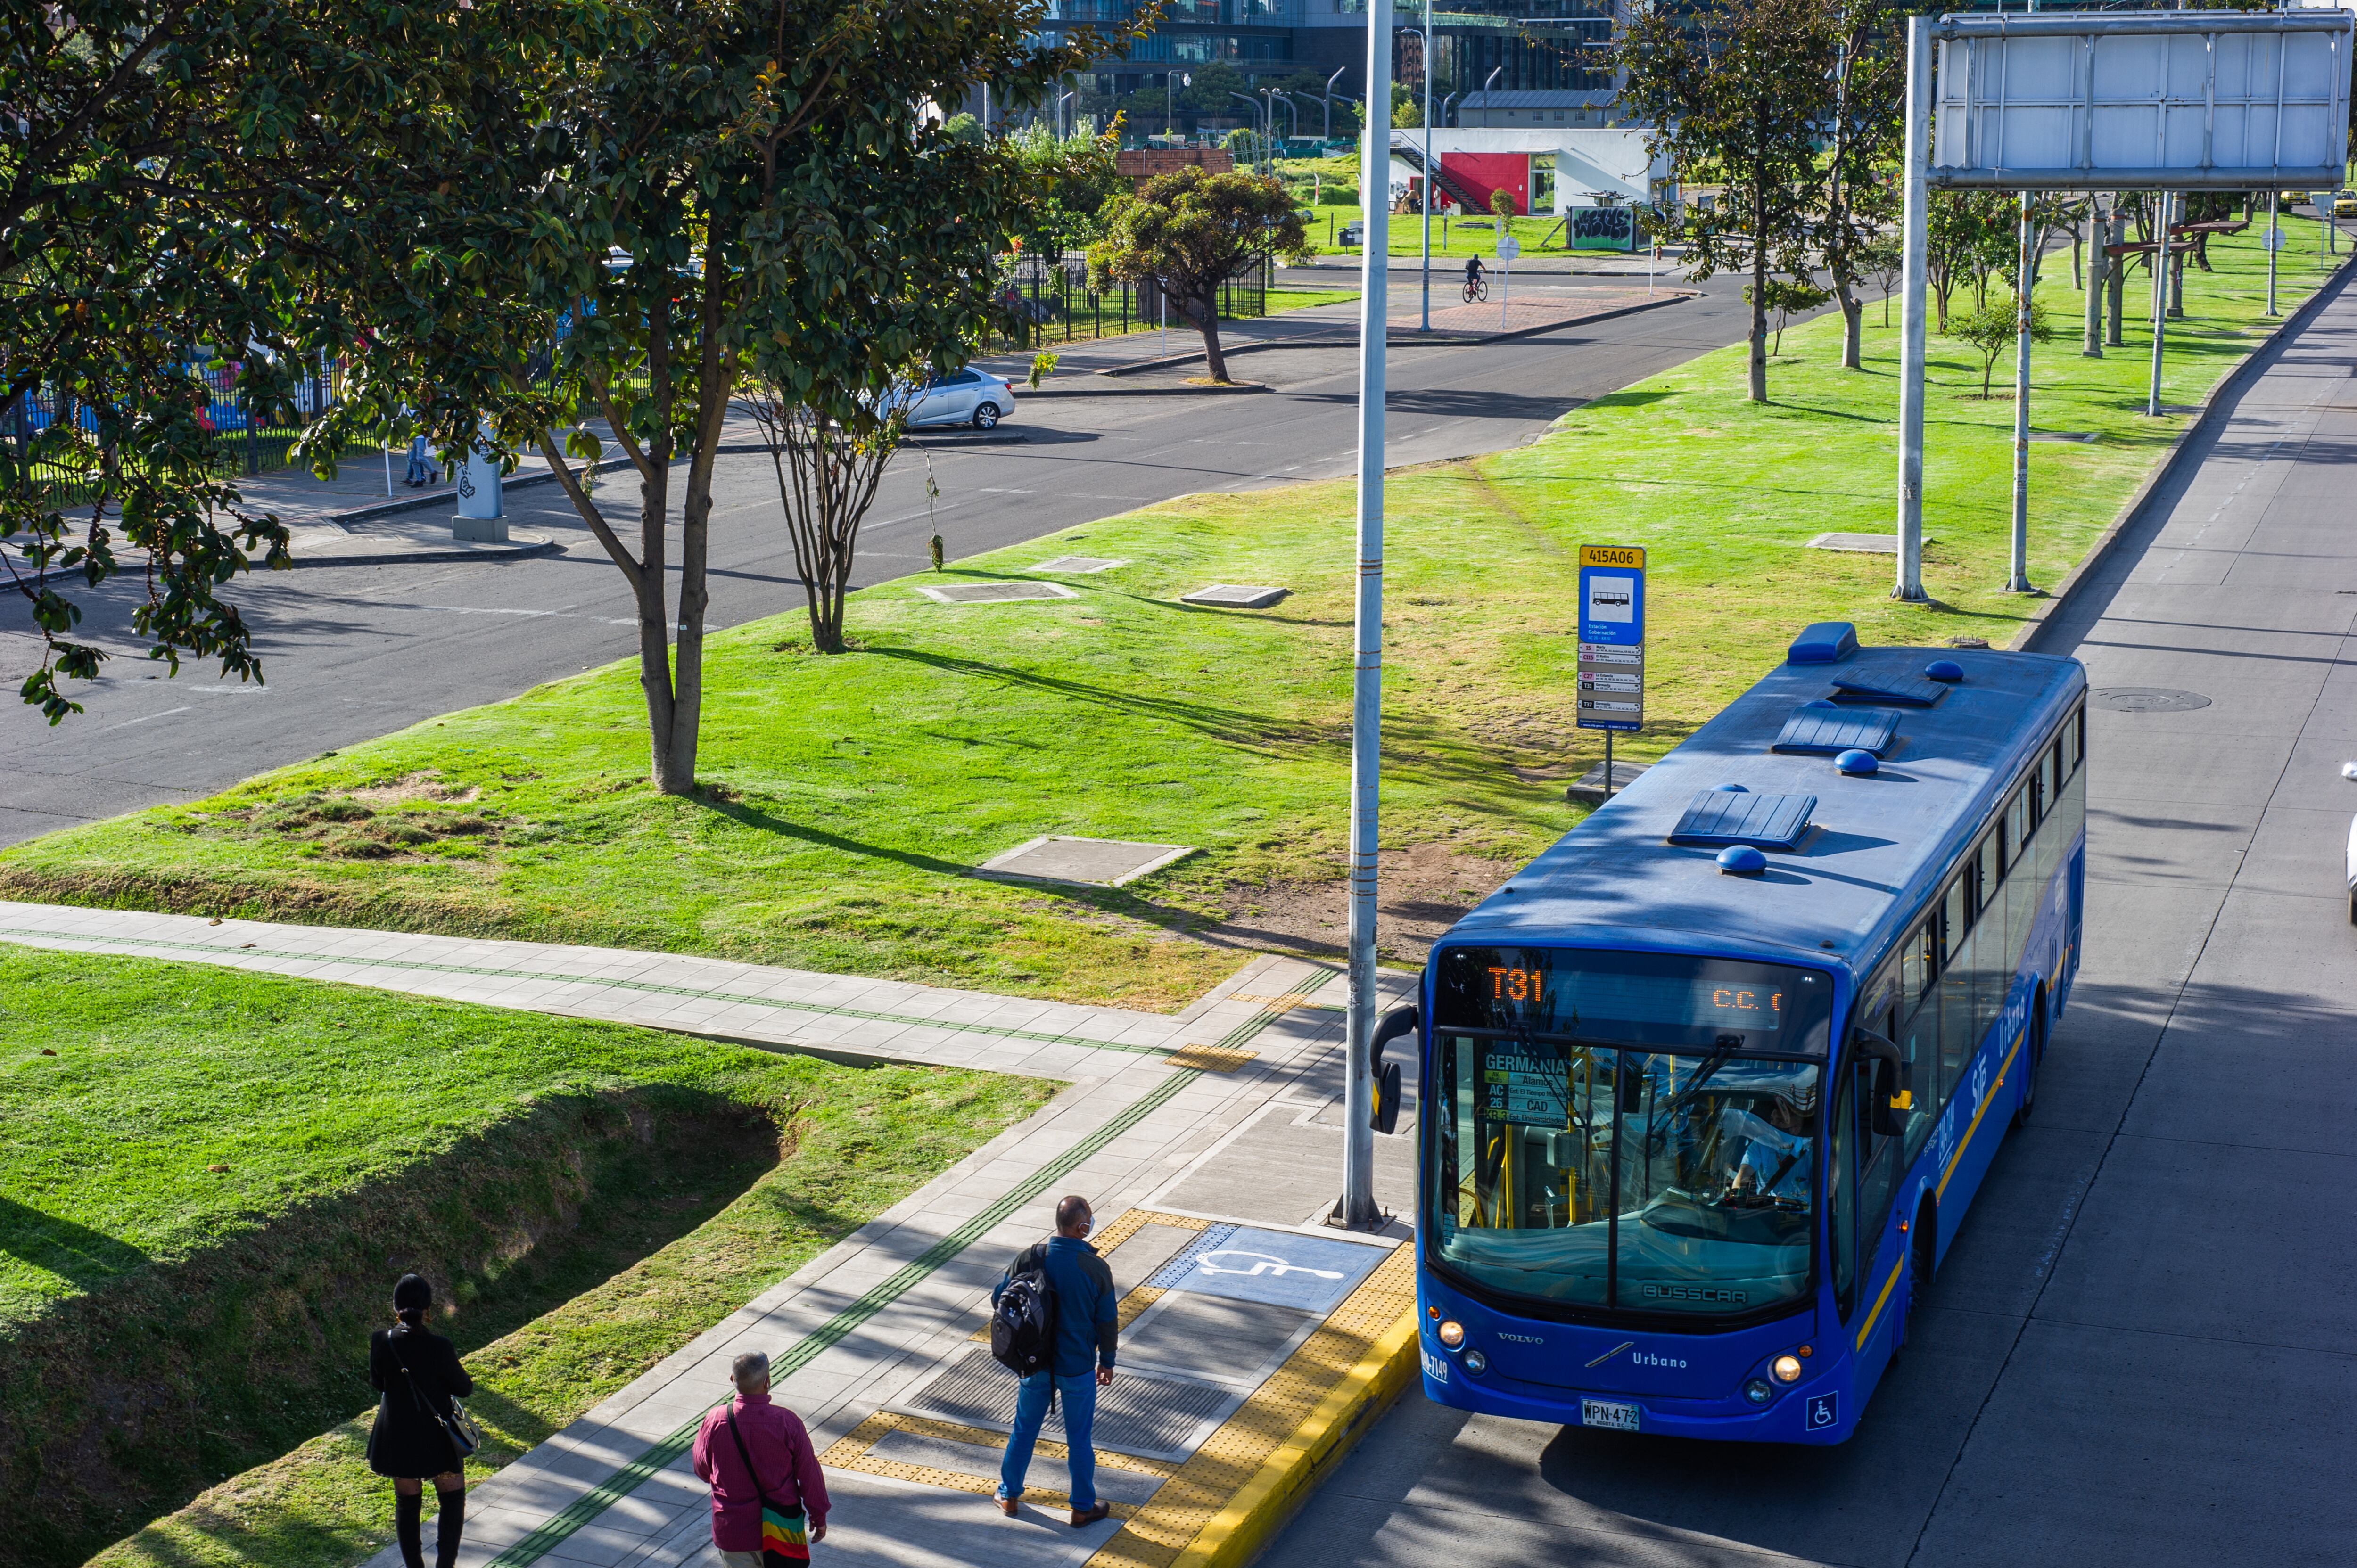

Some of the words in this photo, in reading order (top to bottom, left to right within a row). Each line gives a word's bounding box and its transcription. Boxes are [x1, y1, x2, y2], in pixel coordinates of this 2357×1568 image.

[1589, 550, 1633, 564] 415A06
[1489, 967, 1540, 1001] T31
[2000, 995, 2025, 1058] Urbano
[1486, 1054, 1566, 1075] GERMANIA
[1522, 1074, 1553, 1086] Álamos
[1489, 1084, 1504, 1096] AC
[1526, 1089, 1545, 1097] Tiempo
[1490, 1097, 1503, 1108] 26
[1527, 1100, 1548, 1112] CAD
[1522, 1115, 1565, 1125] Universidades
[1643, 1285, 1746, 1303] BUSSCAR
[1497, 1332, 1544, 1344] VOLVO
[1633, 1352, 1687, 1368] Urbano
